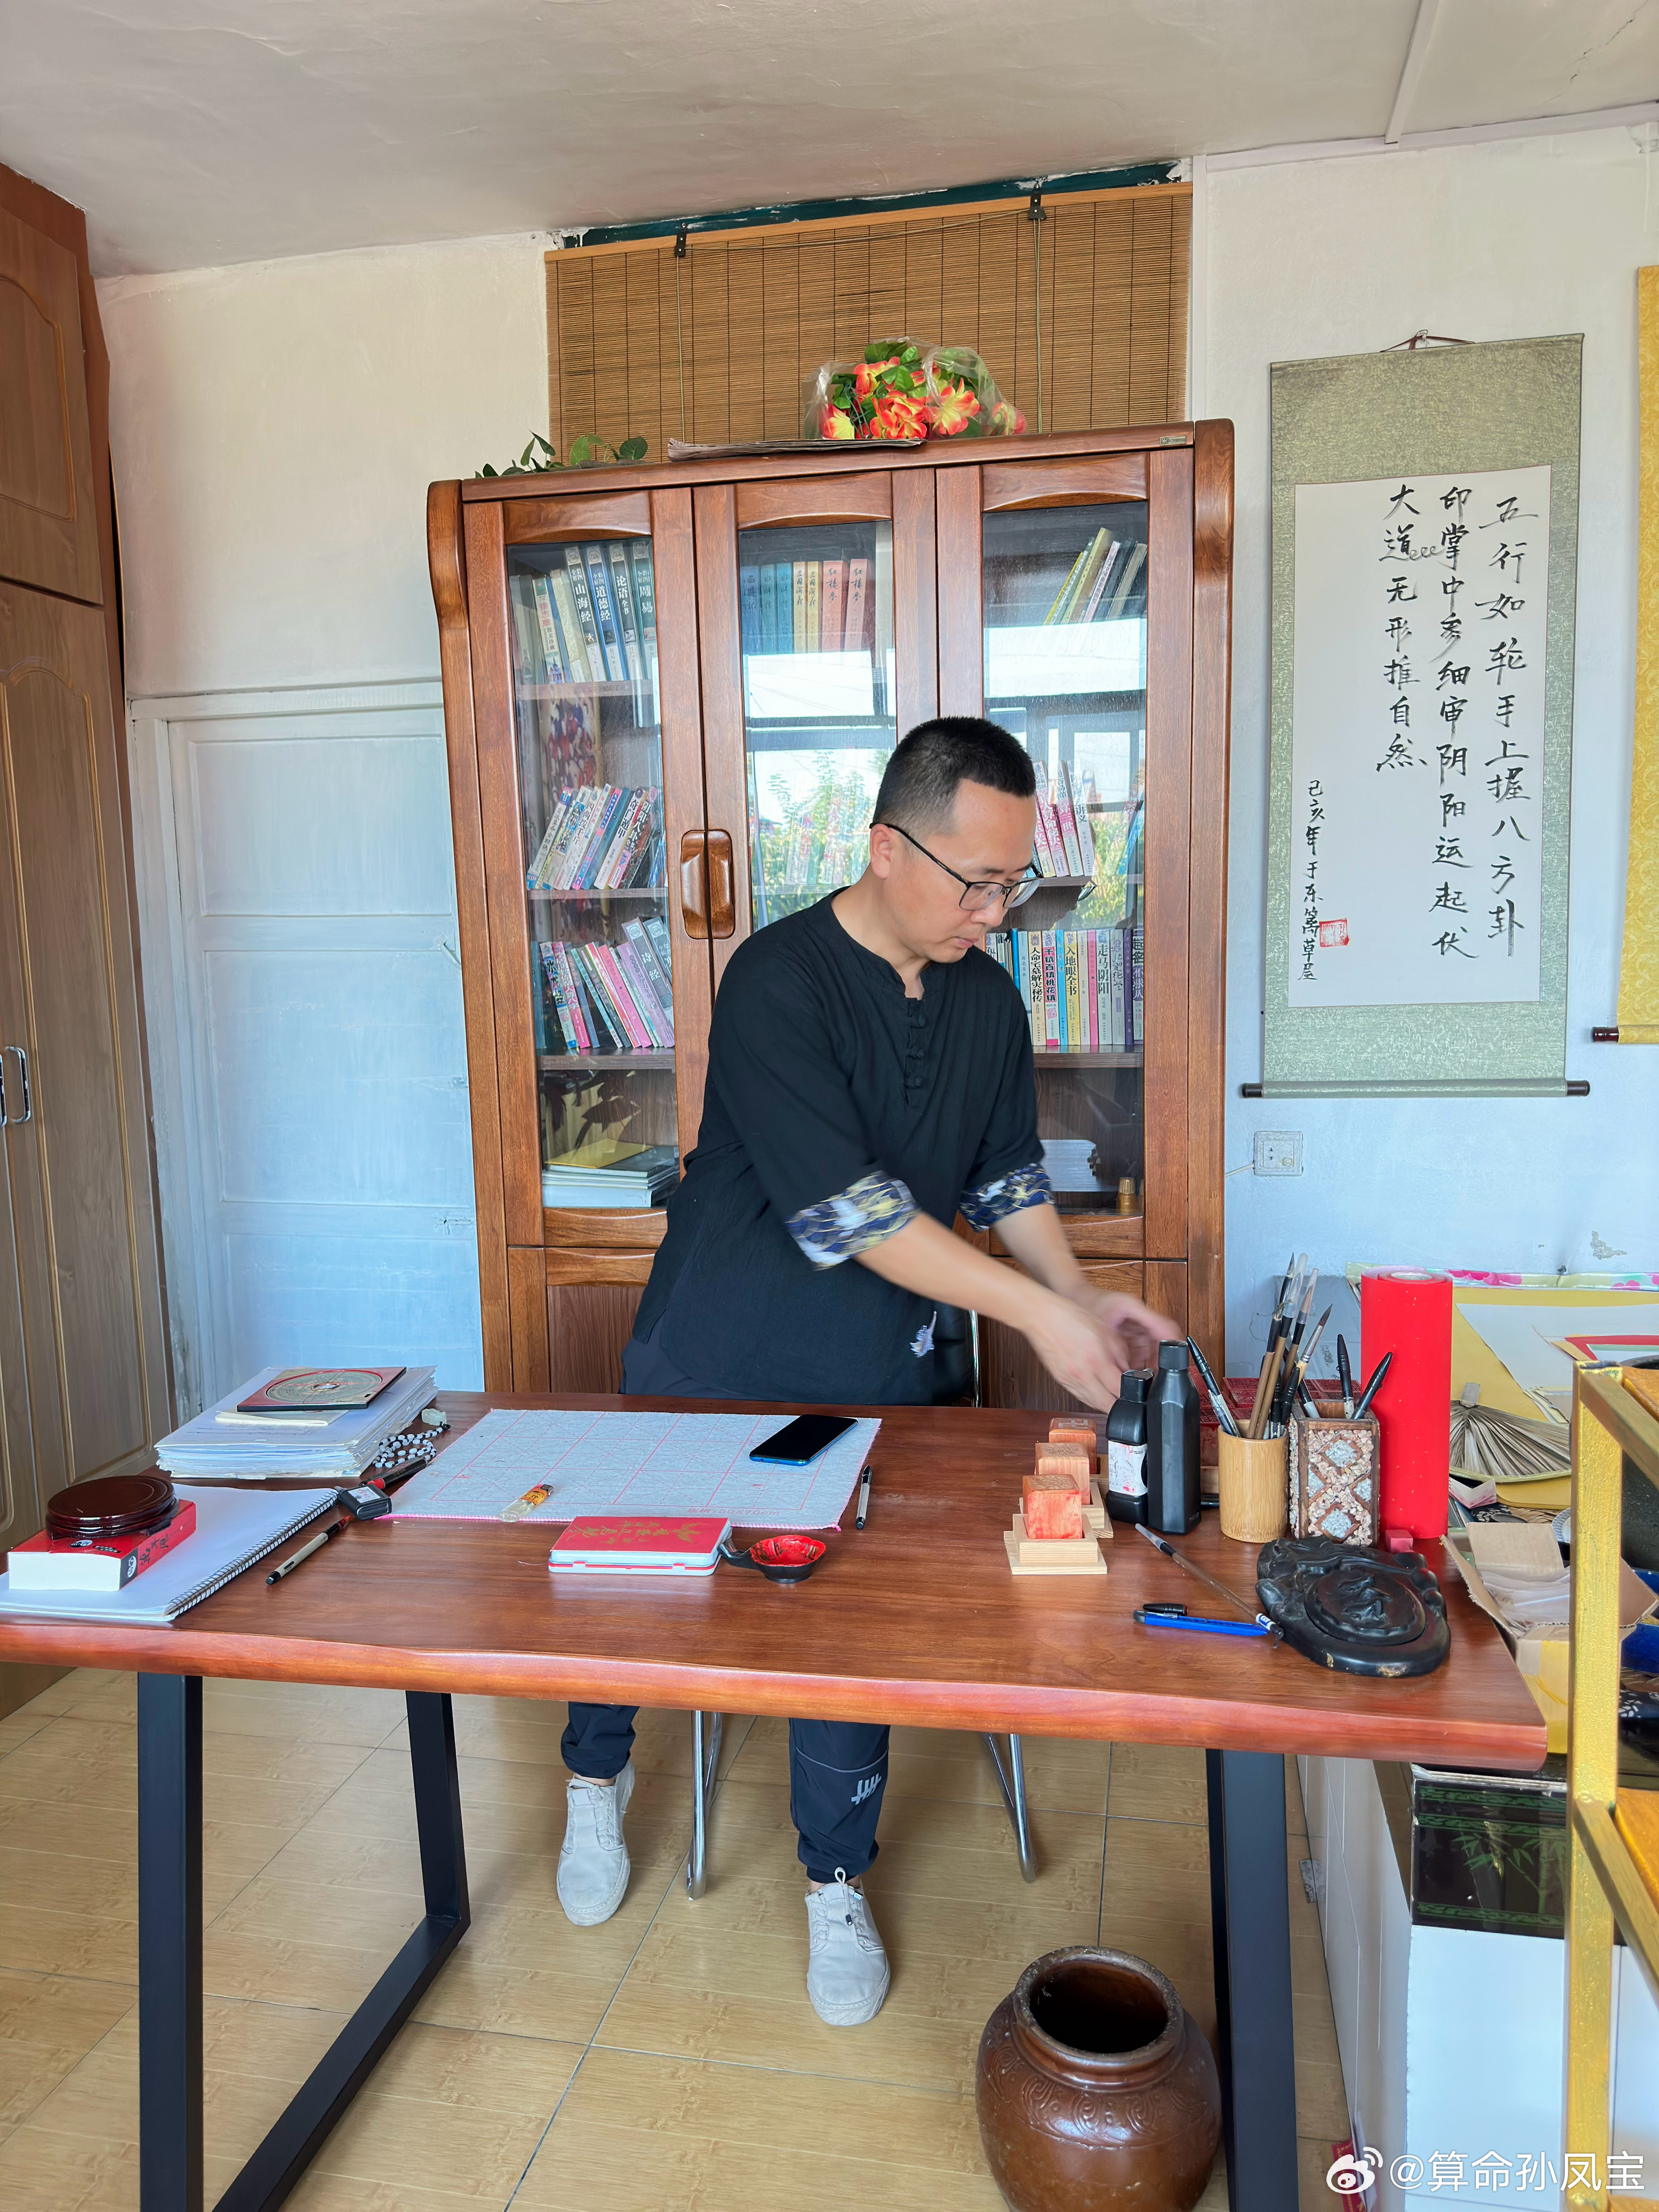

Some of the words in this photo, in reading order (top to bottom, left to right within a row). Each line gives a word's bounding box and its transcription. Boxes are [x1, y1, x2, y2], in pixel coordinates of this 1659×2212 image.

[575, 584, 592, 623] 山海经
[596, 586, 611, 622] 道德经
[639, 585, 653, 613] 周易
[1375, 484, 1428, 772] 大道无形推自然
[1474, 496, 1539, 957] 五行如轮手上握八方卦
[617, 799, 639, 839] 奇门遁甲
[640, 952, 660, 981] 诗经
[1064, 946, 1077, 996] 入地眼全书
[1097, 943, 1110, 994] 走马阴阳
